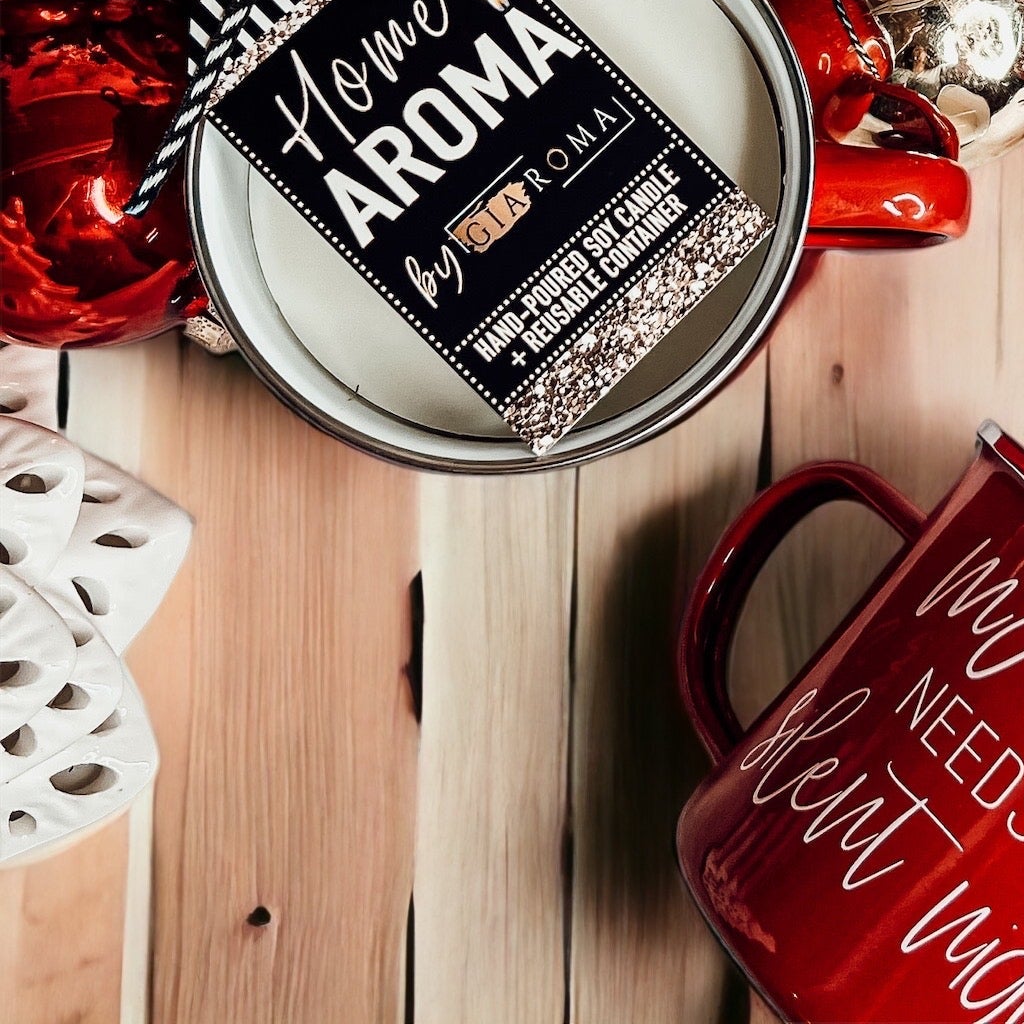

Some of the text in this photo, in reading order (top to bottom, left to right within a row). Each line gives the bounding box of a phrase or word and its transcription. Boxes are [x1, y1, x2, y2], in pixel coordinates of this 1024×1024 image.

[323, 7, 583, 249] AROMA
[405, 245, 463, 309] by
[473, 163, 681, 362] HAND-POURED SOY CANDLE
[521, 268, 608, 354] REUSABLE
[599, 193, 688, 279] CONTAINER
